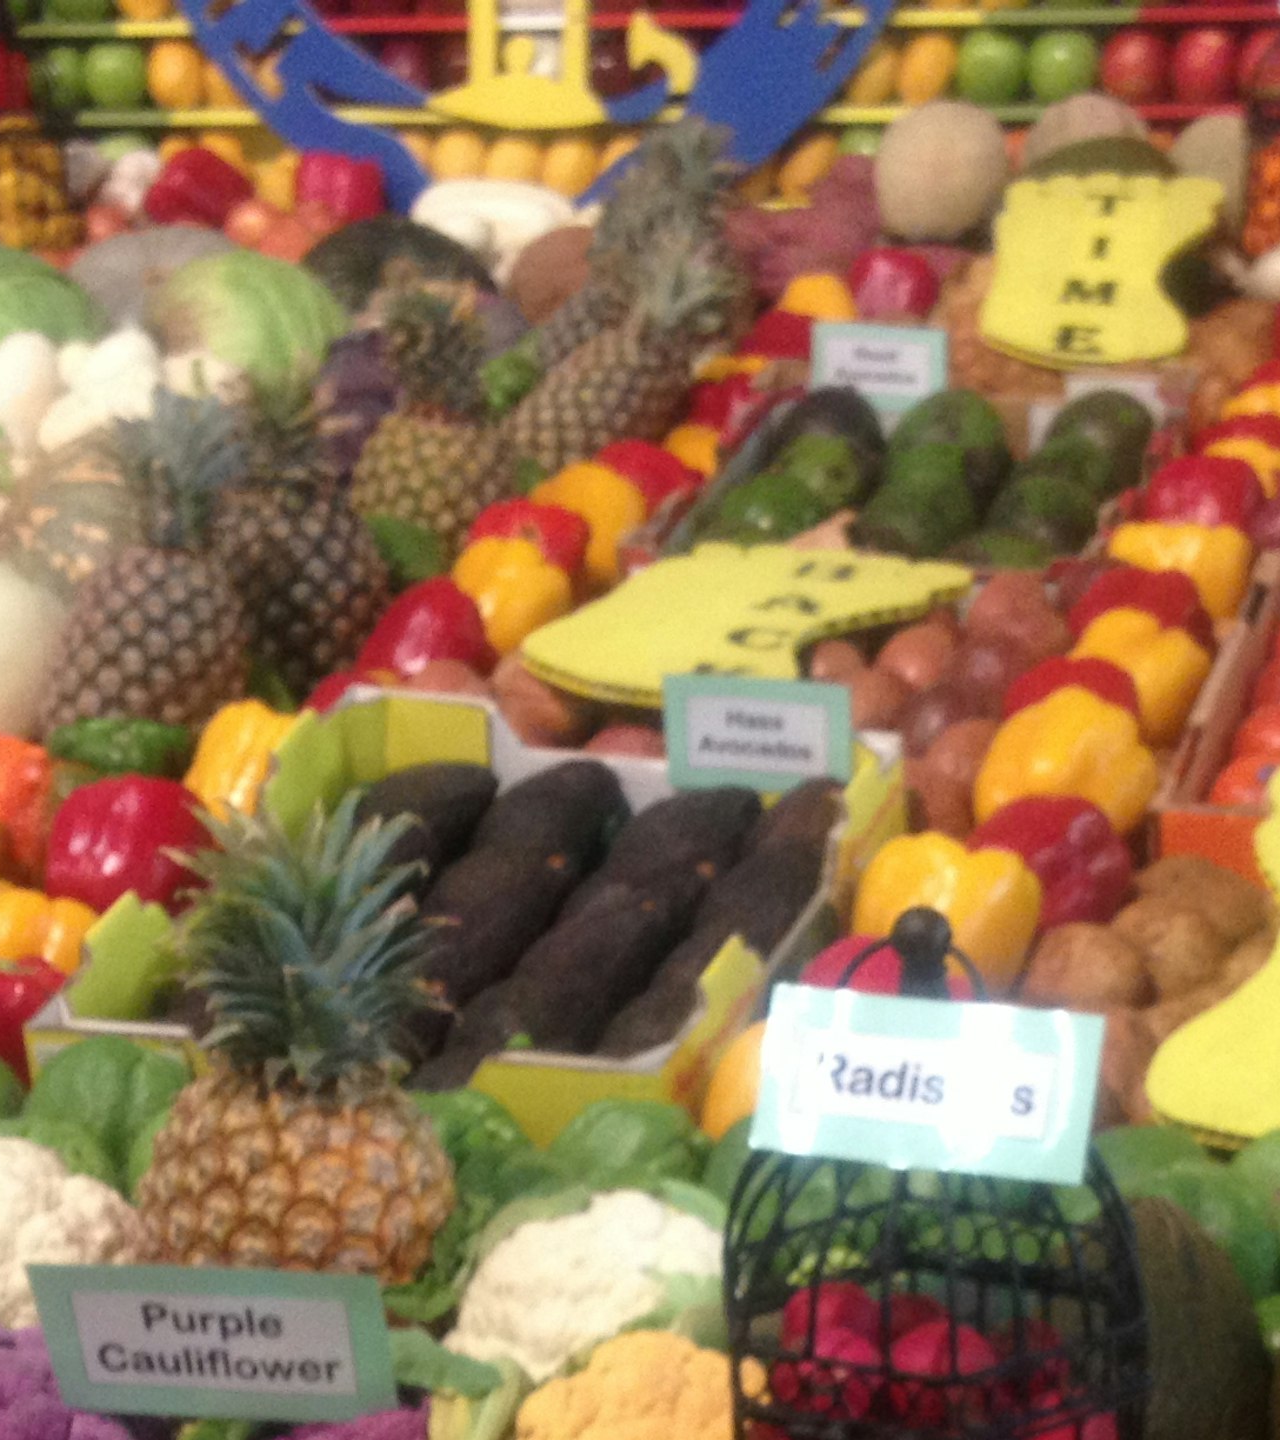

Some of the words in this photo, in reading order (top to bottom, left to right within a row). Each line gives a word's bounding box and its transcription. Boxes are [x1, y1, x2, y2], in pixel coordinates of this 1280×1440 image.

[1056, 193, 1136, 354] TIME
[817, 1052, 1037, 1117] Radiss
[139, 1302, 283, 1341] Purple
[97, 1342, 342, 1384] Cauliflower
